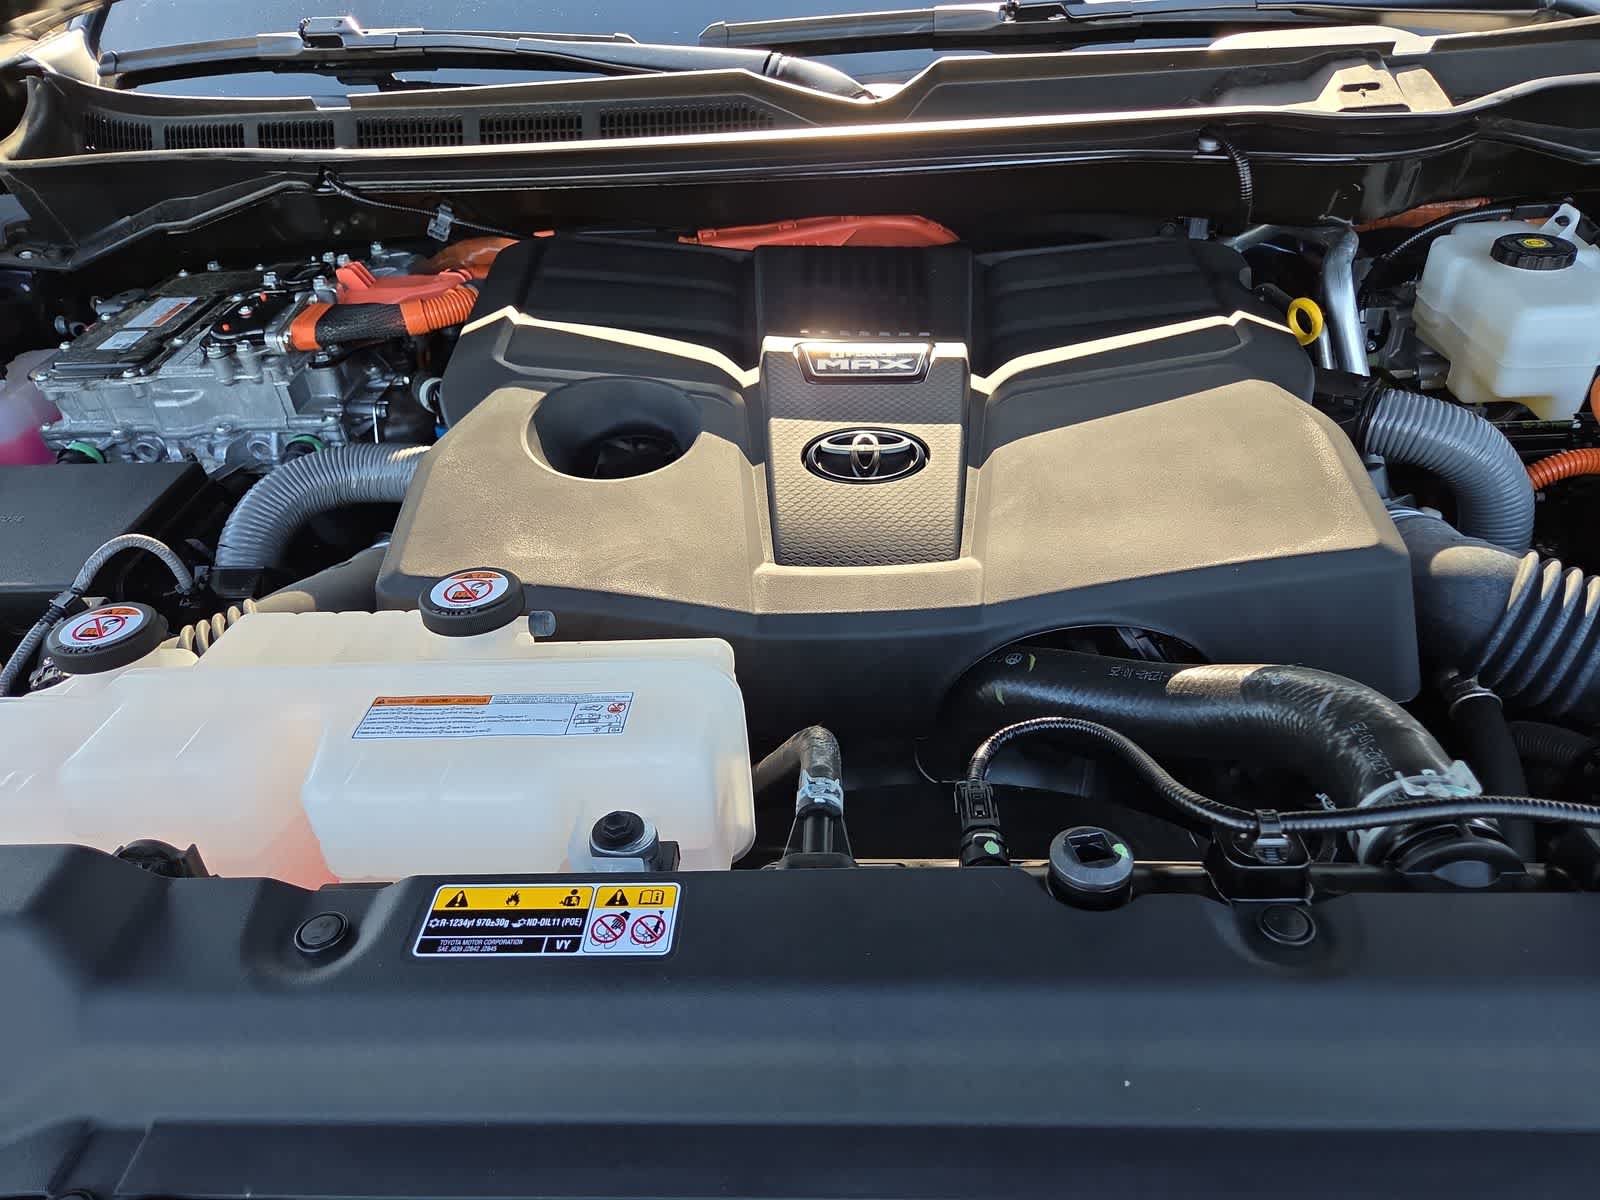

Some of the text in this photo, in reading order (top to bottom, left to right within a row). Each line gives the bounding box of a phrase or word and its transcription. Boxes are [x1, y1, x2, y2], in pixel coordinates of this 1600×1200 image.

[816, 358, 914, 370] MAX
[440, 918, 476, 928] R-1234yf
[561, 917, 583, 928] (POE)
[556, 939, 571, 950] VY
